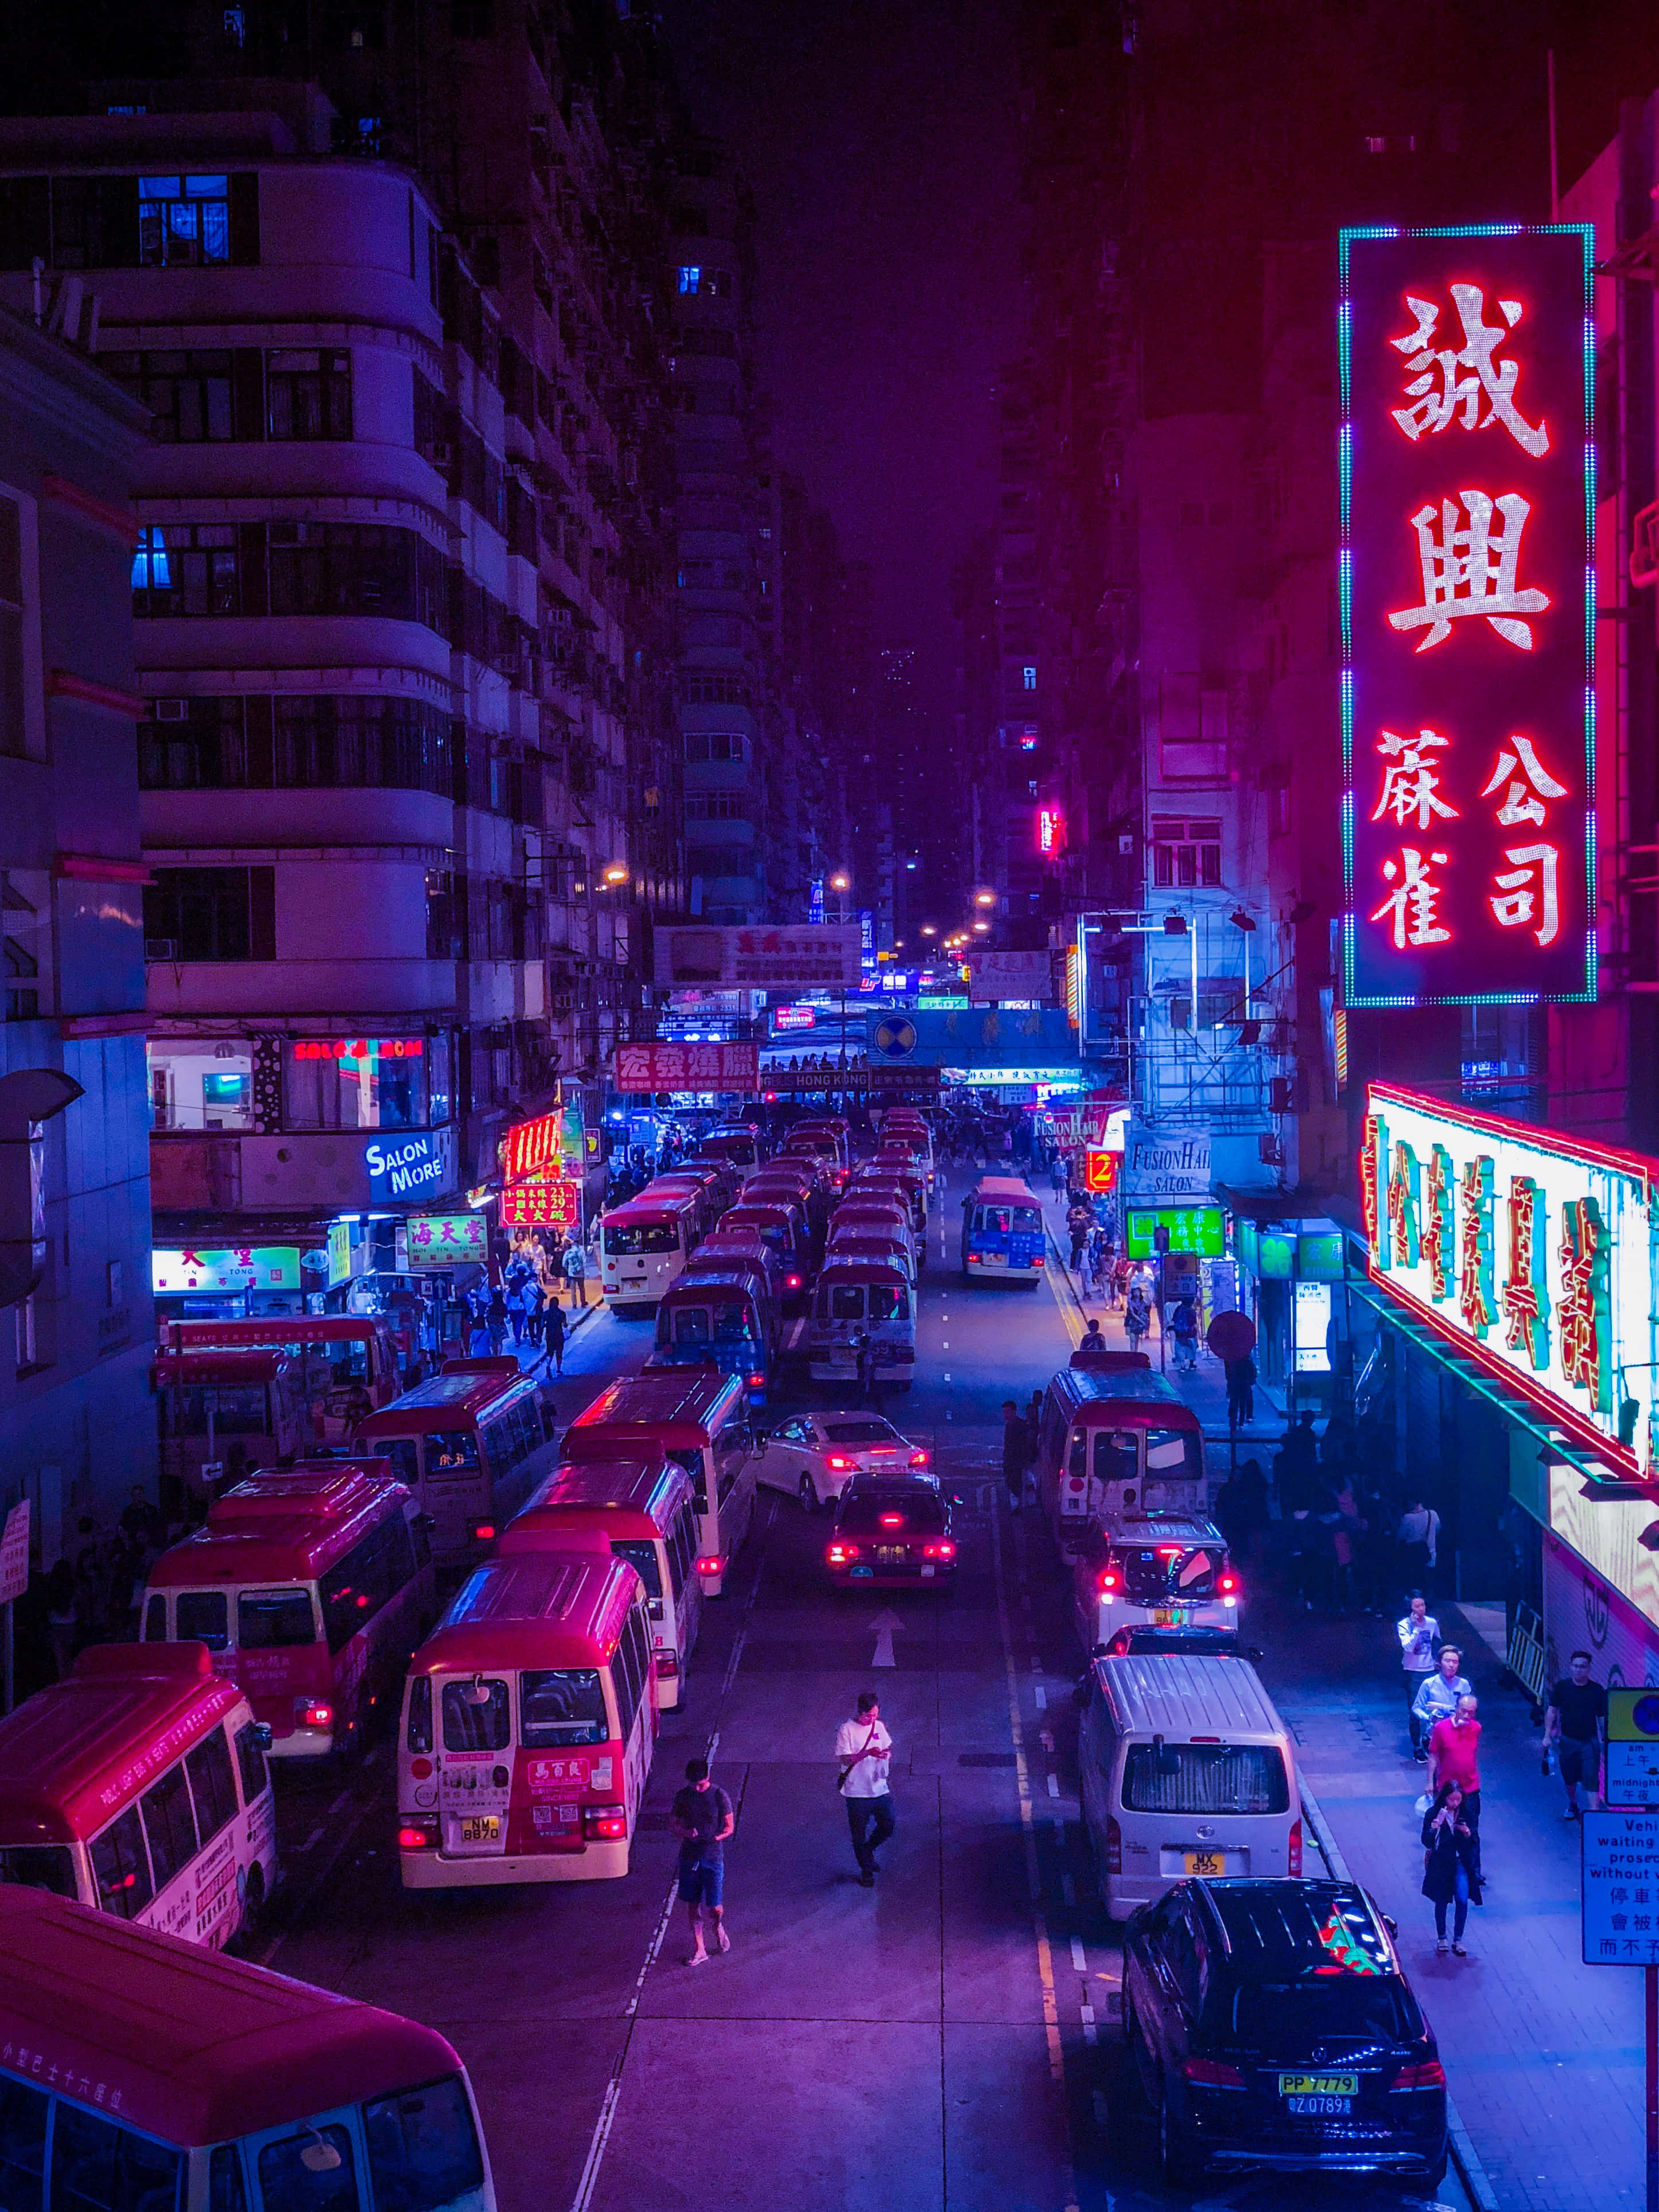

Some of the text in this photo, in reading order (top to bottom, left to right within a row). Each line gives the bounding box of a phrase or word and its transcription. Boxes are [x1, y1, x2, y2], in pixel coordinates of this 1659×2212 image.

[1389, 284, 1551, 653] 誠興
[1481, 734, 1568, 947] 公司
[797, 1074, 831, 1086] HONG
[834, 1073, 867, 1085] KONG
[1045, 1134, 1085, 1147] SALON
[366, 1139, 428, 1177] SALON
[1093, 1154, 1112, 1181] 2
[391, 1159, 442, 1194] MORE
[1155, 1177, 1192, 1192] SALON
[550, 1186, 565, 1198] 23
[550, 1198, 566, 1209] 29
[411, 1219, 485, 1245] 海天堂
[1168, 1225, 1220, 1237] 務中心
[1306, 1241, 1343, 1262] 宏康
[1622, 1754, 1649, 1767] 上午
[1622, 1789, 1649, 1801] 午夜
[472, 1818, 489, 1829] NM
[464, 1829, 499, 1840] 8870
[1598, 1835, 1655, 1849] waiting
[1196, 1854, 1213, 1864] MX
[1192, 1864, 1218, 1875] 922
[1590, 1866, 1650, 1880] without
[1610, 1887, 1659, 1906] 停車
[1610, 1912, 1659, 1932] 會被
[1283, 2077, 1352, 2091] PP 7779
